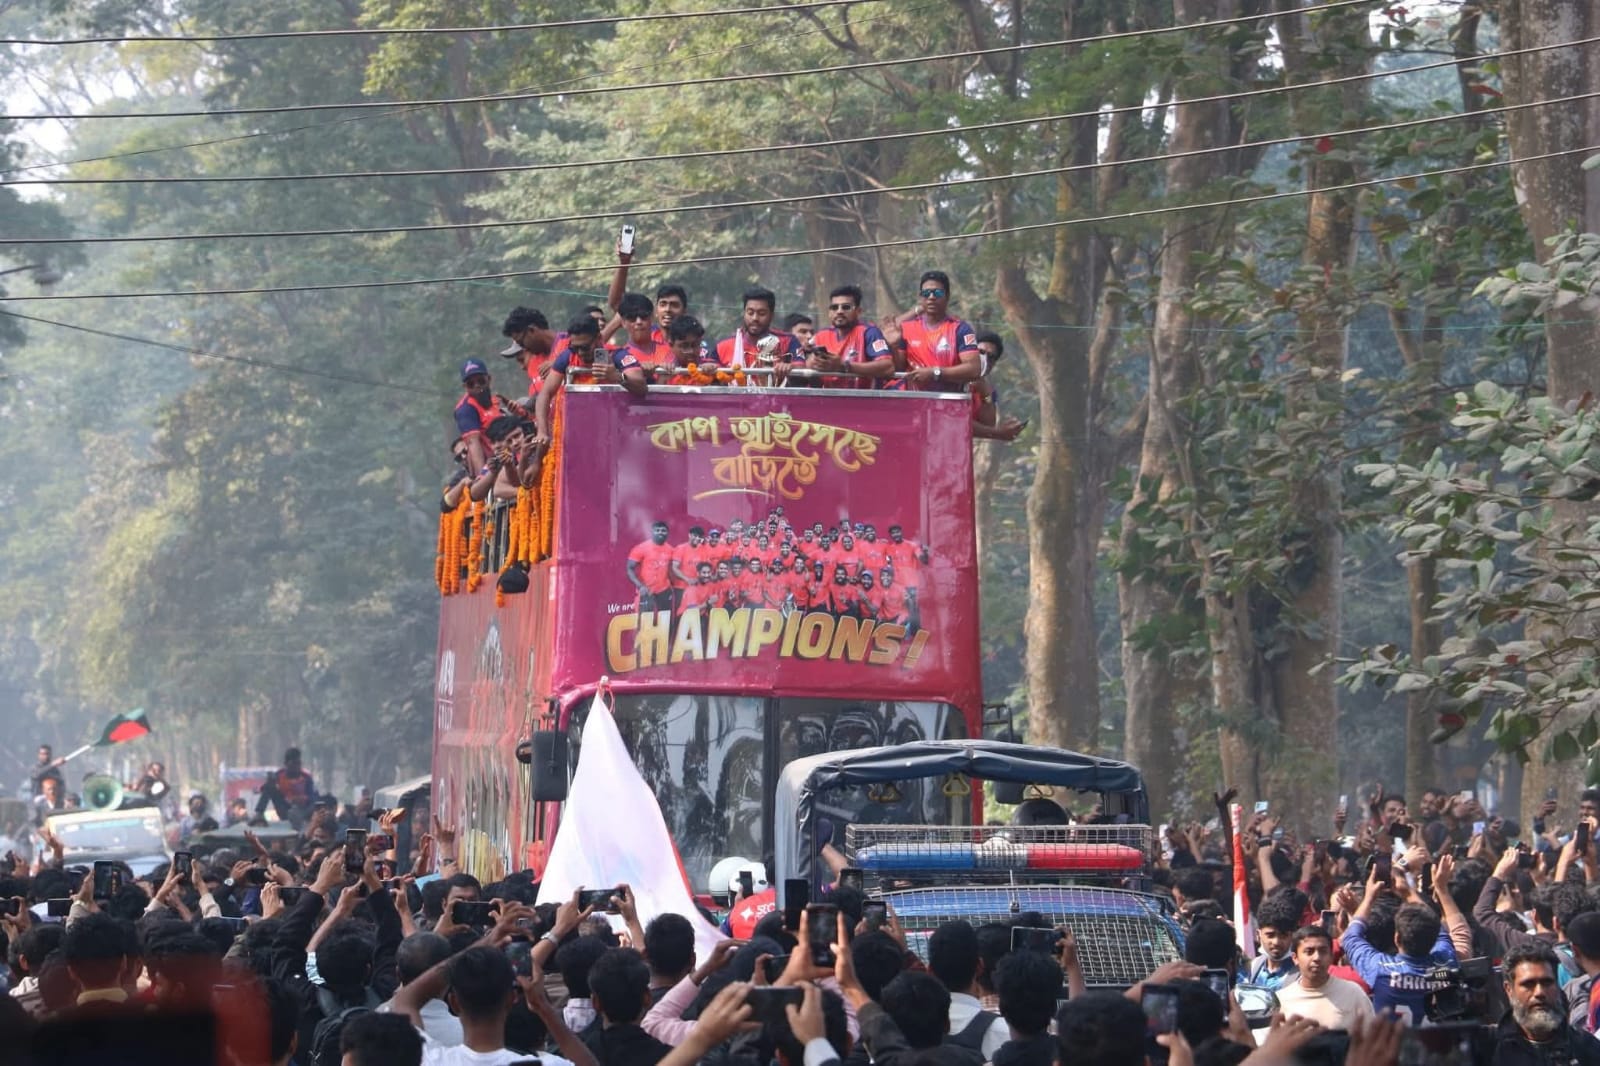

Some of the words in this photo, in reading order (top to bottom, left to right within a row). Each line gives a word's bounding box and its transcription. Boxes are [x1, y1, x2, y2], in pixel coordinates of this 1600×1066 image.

[647, 416, 721, 452] কাপ
[711, 443, 819, 500] বাড়িতে
[607, 603, 620, 614] We
[622, 603, 635, 612] are
[606, 607, 930, 673] CHAMPIONS!
